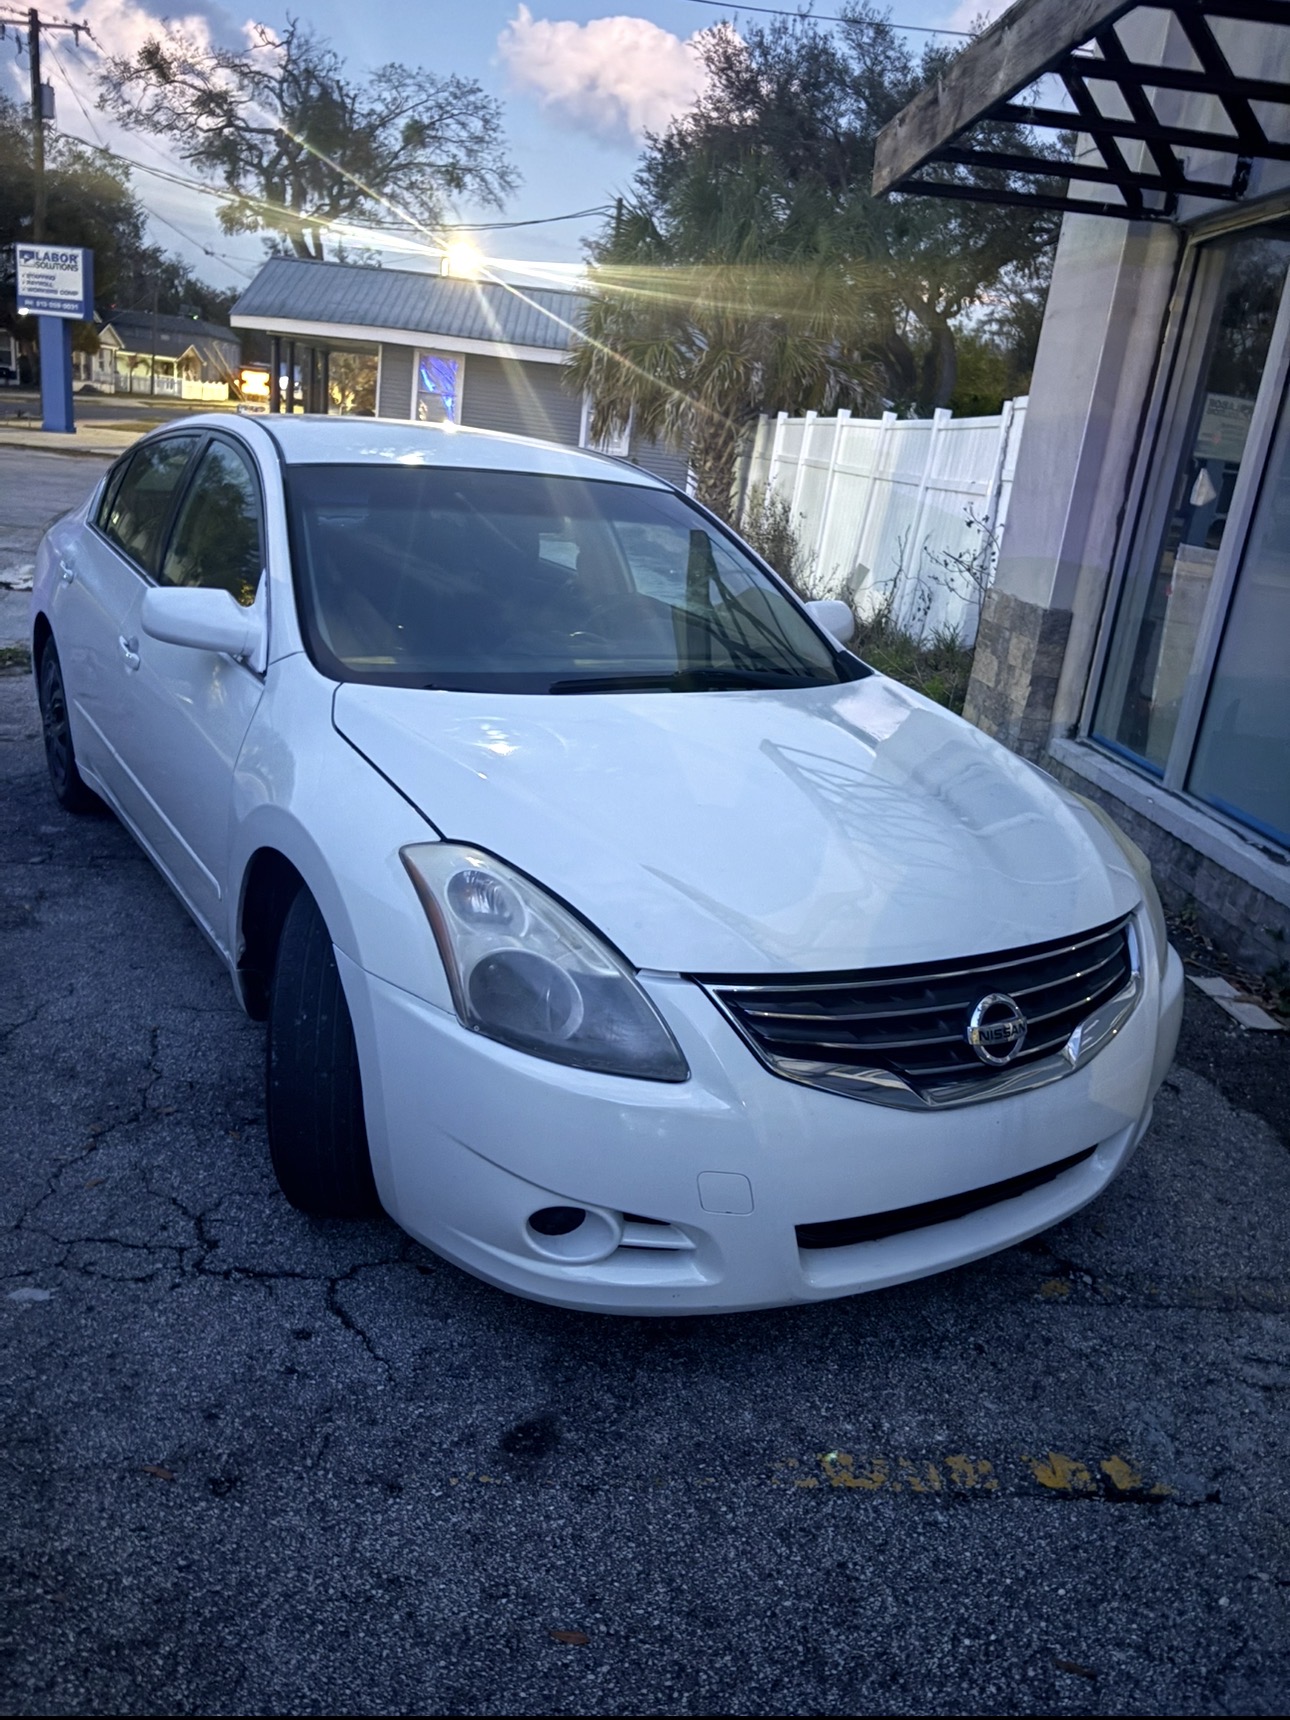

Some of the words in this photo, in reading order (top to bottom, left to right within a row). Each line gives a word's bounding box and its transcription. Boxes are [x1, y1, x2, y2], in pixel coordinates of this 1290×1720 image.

[35, 251, 78, 264] LABOR
[35, 261, 79, 272] SOLUTIONS
[978, 1023, 1026, 1041] NISSAN
